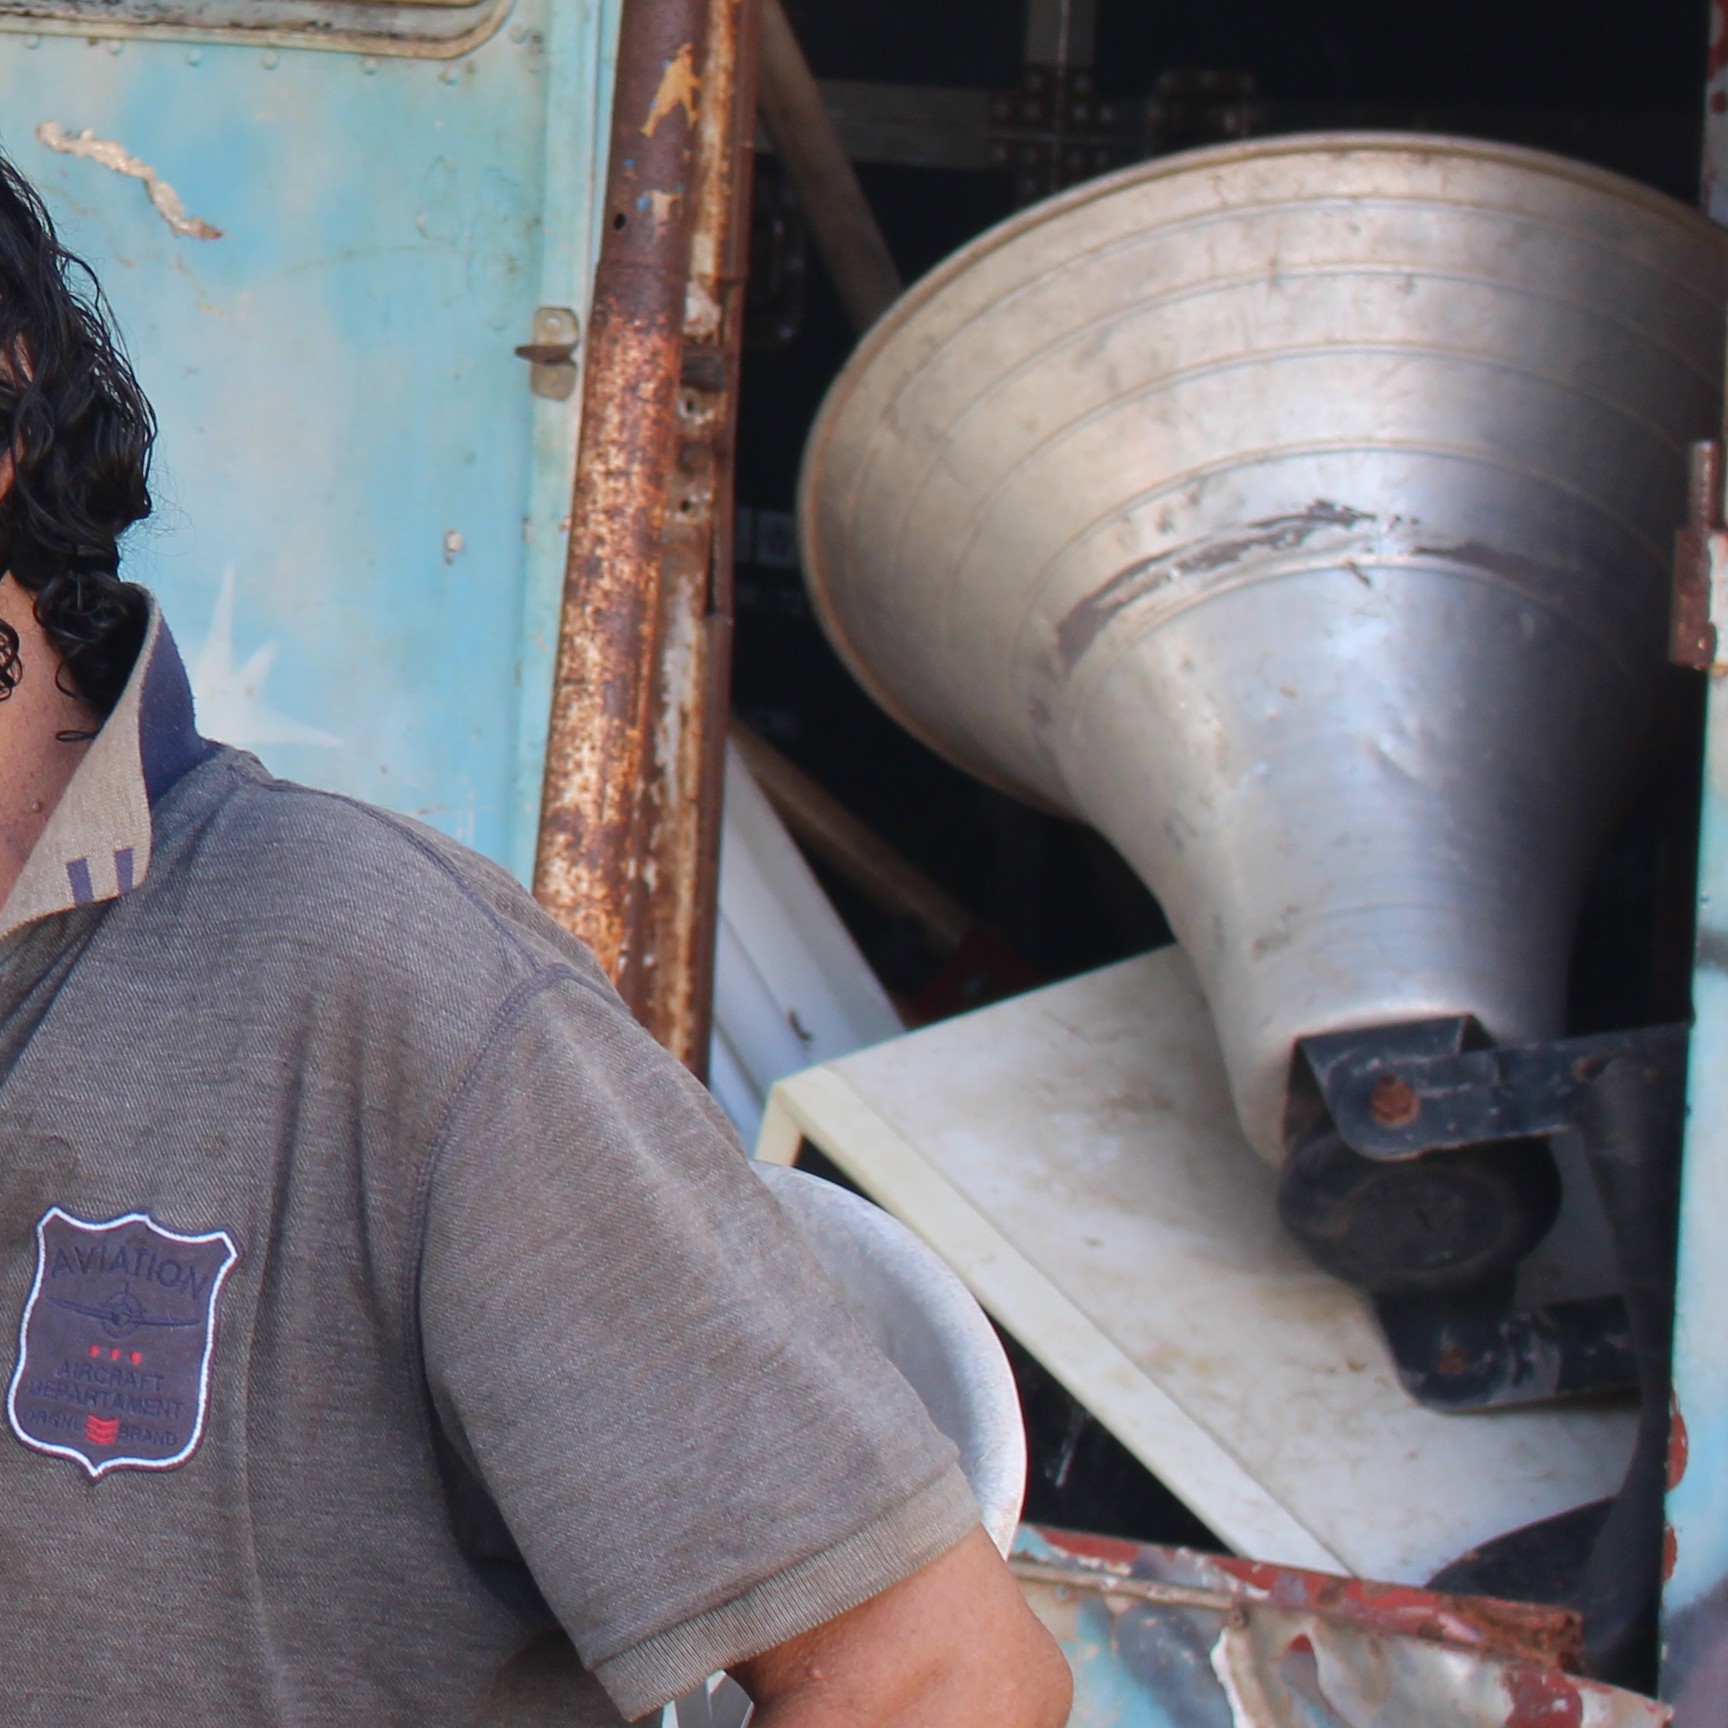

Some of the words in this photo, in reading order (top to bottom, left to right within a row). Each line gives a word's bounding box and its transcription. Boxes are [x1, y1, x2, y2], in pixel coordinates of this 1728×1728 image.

[50, 1245, 209, 1301] AVIATION
[56, 1359, 164, 1392] AIRCRAFT
[118, 1422, 178, 1447] BRAND
